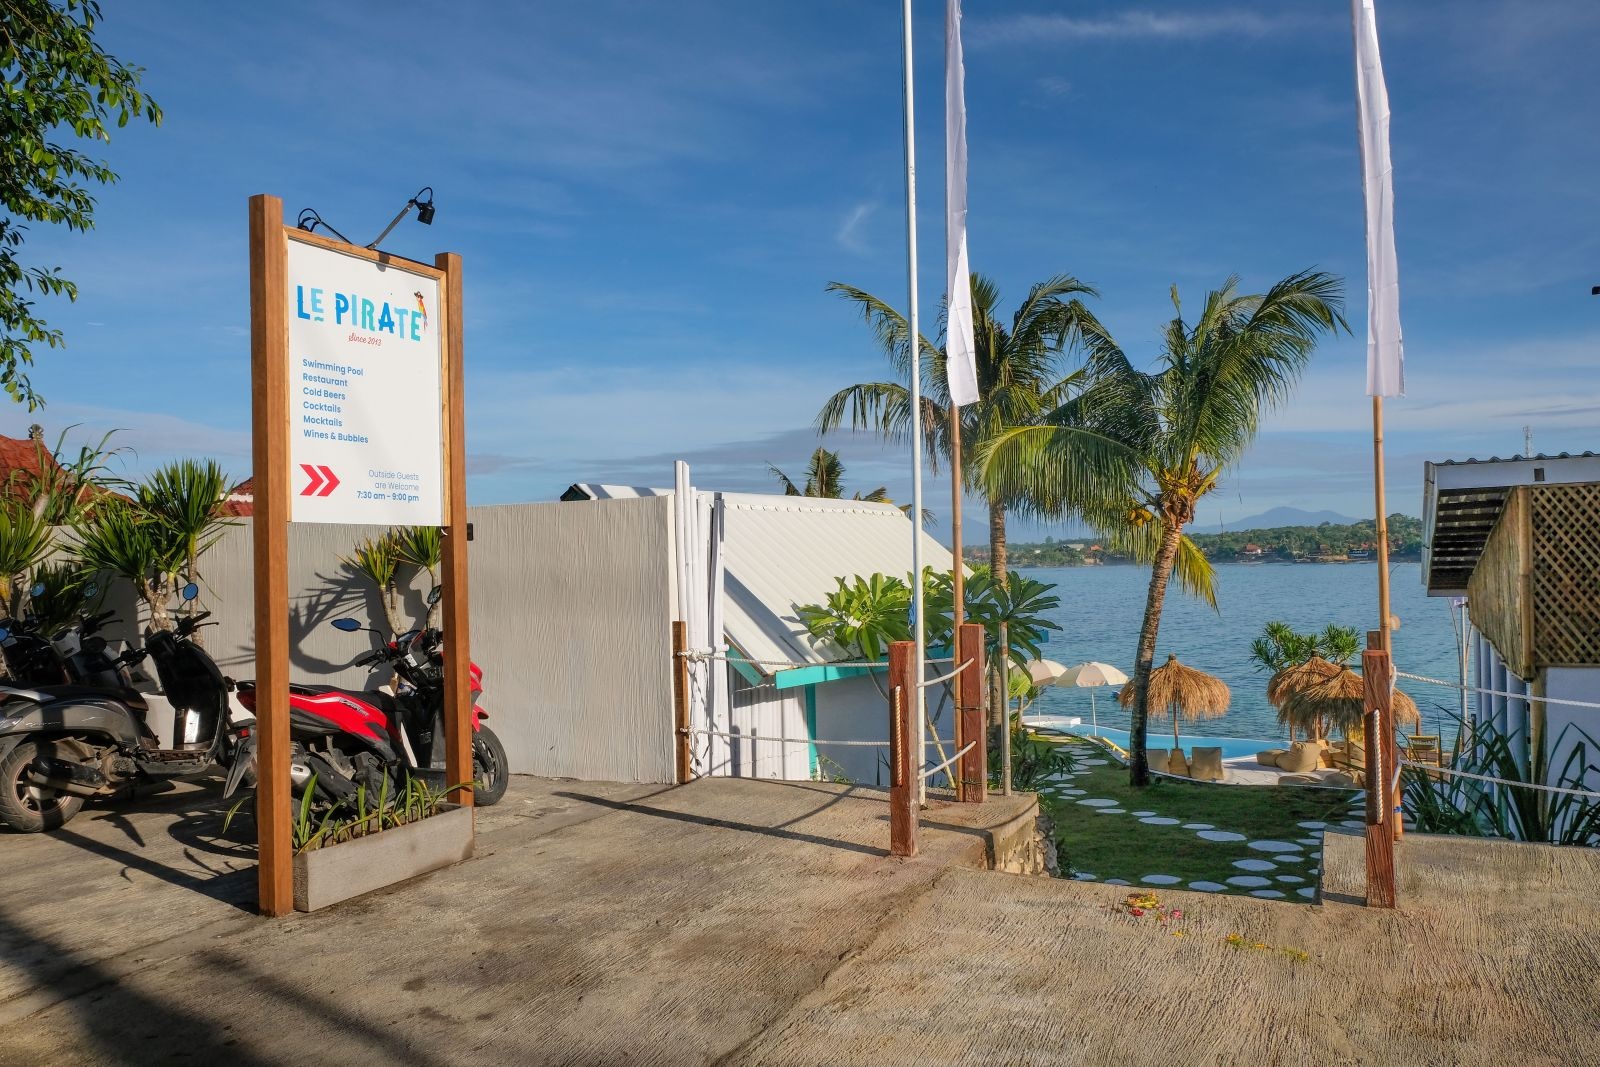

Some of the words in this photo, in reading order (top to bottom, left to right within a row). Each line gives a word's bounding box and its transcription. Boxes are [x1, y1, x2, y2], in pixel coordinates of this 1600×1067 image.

[297, 285, 324, 321] LE
[335, 292, 422, 341] PIRATE
[348, 332, 366, 343] Since
[302, 358, 346, 375] Swimming
[347, 366, 364, 376] Pool
[302, 373, 348, 387] Restaurant
[303, 387, 322, 397] Cold
[323, 389, 346, 400] Beers
[303, 401, 341, 413] Cocktails
[303, 415, 343, 427] Mocktails
[303, 429, 329, 440] Wines
[330, 432, 336, 440] &
[338, 433, 369, 444] Bubbles
[368, 469, 396, 479] Outside
[397, 472, 420, 481] Guests
[374, 482, 387, 490] are
[388, 482, 420, 491] Welcome
[357, 490, 372, 499] 7:30
[392, 492, 407, 501] 9:00
[407, 494, 420, 503] pm
